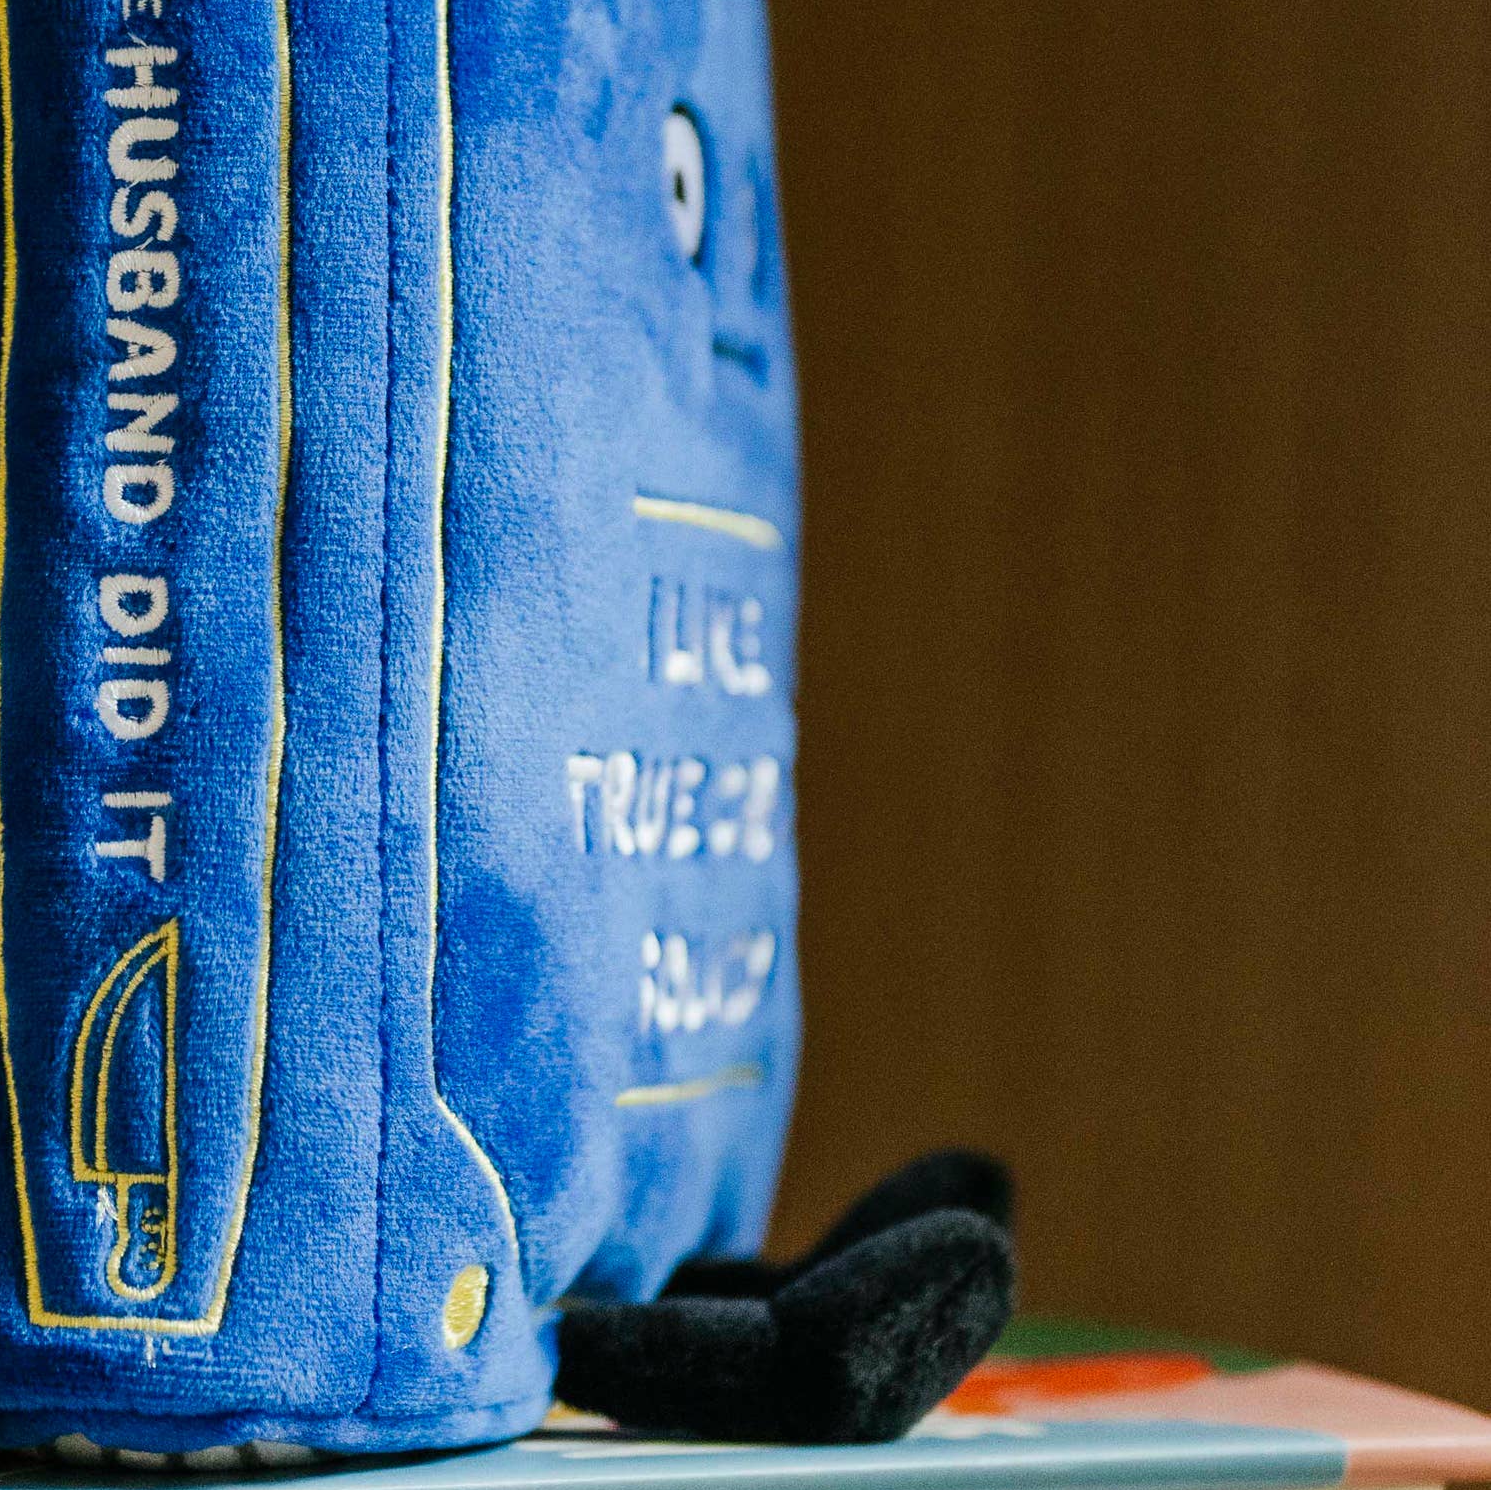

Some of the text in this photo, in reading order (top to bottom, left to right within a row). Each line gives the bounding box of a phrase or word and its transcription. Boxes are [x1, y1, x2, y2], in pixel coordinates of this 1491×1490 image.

[102, 45, 181, 526] HUSBAND
[92, 572, 172, 743] DID
[93, 791, 174, 884] IT
[565, 750, 704, 859] TRUE
